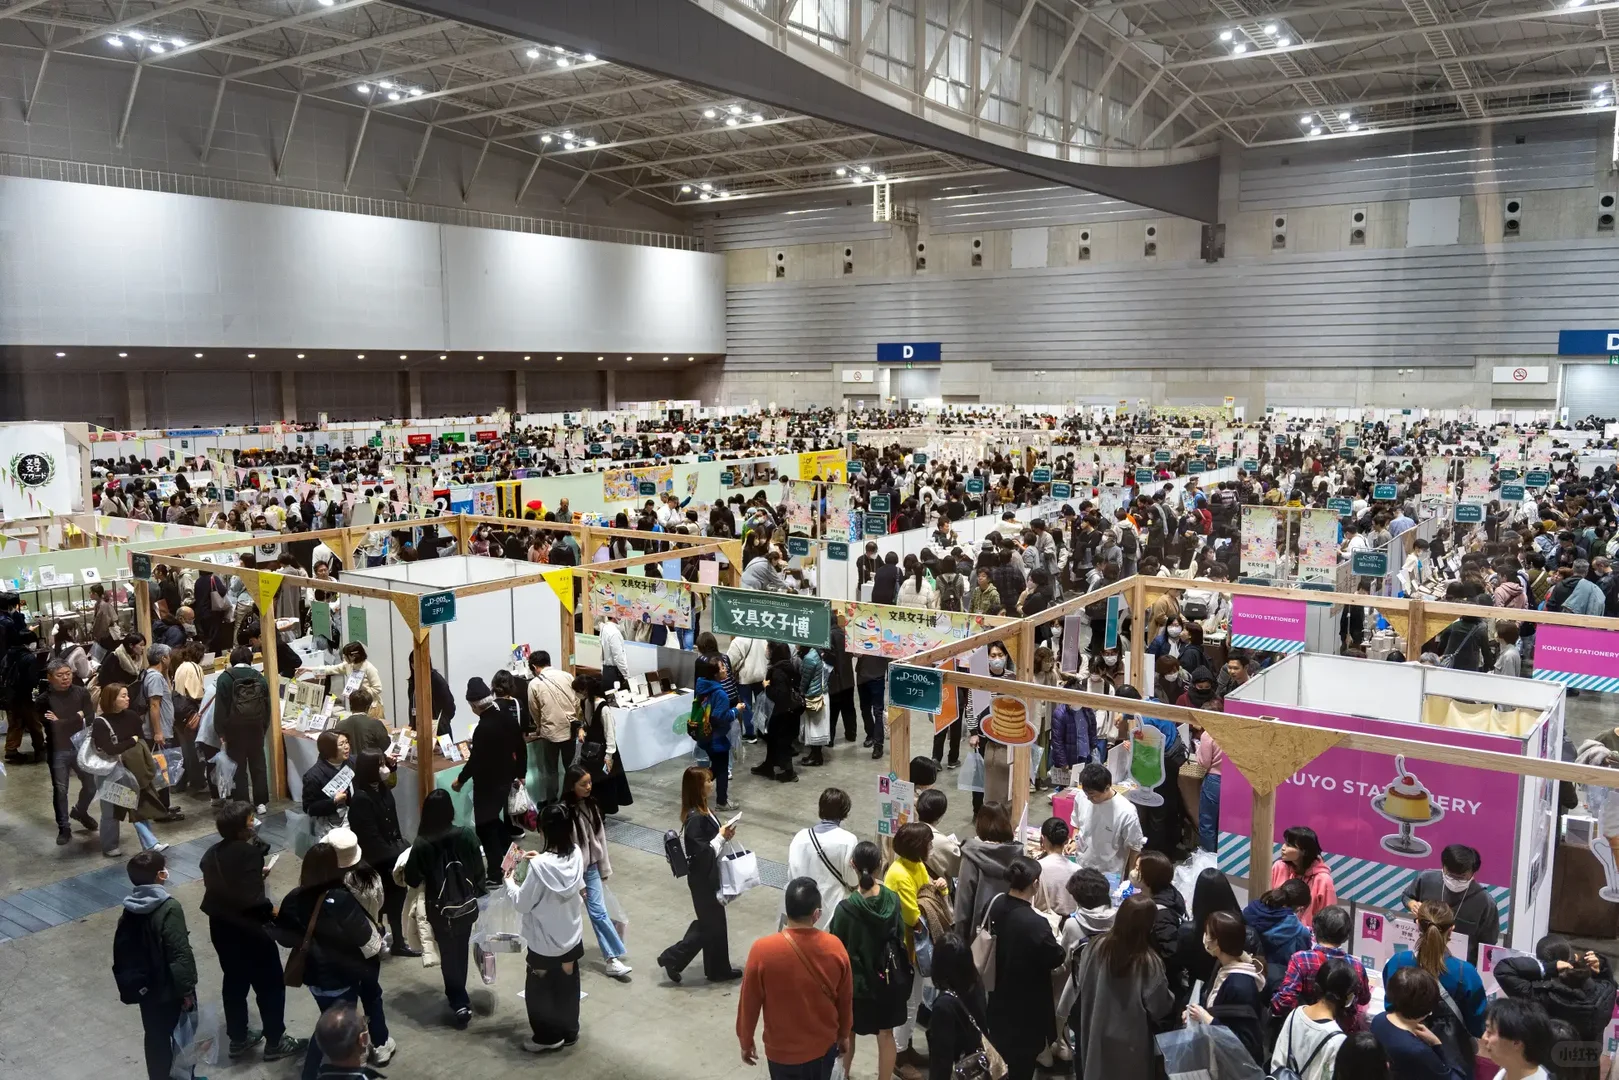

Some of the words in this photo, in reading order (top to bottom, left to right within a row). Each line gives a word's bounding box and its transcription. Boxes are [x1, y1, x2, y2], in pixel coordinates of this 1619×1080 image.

[903, 345, 914, 358] D
[25, 457, 41, 466] 文具
[620, 578, 657, 594] 文具女子博
[730, 608, 810, 638] 文具女子博
[888, 610, 938, 628] 文具女子博
[1264, 616, 1300, 624] STATIONERY
[1542, 644, 1572, 652] KOKUYO
[1574, 648, 1619, 658] STATIONERY
[902, 672, 928, 683] D-006
[906, 687, 924, 697] コクヨ
[1342, 780, 1482, 815] STAERY
